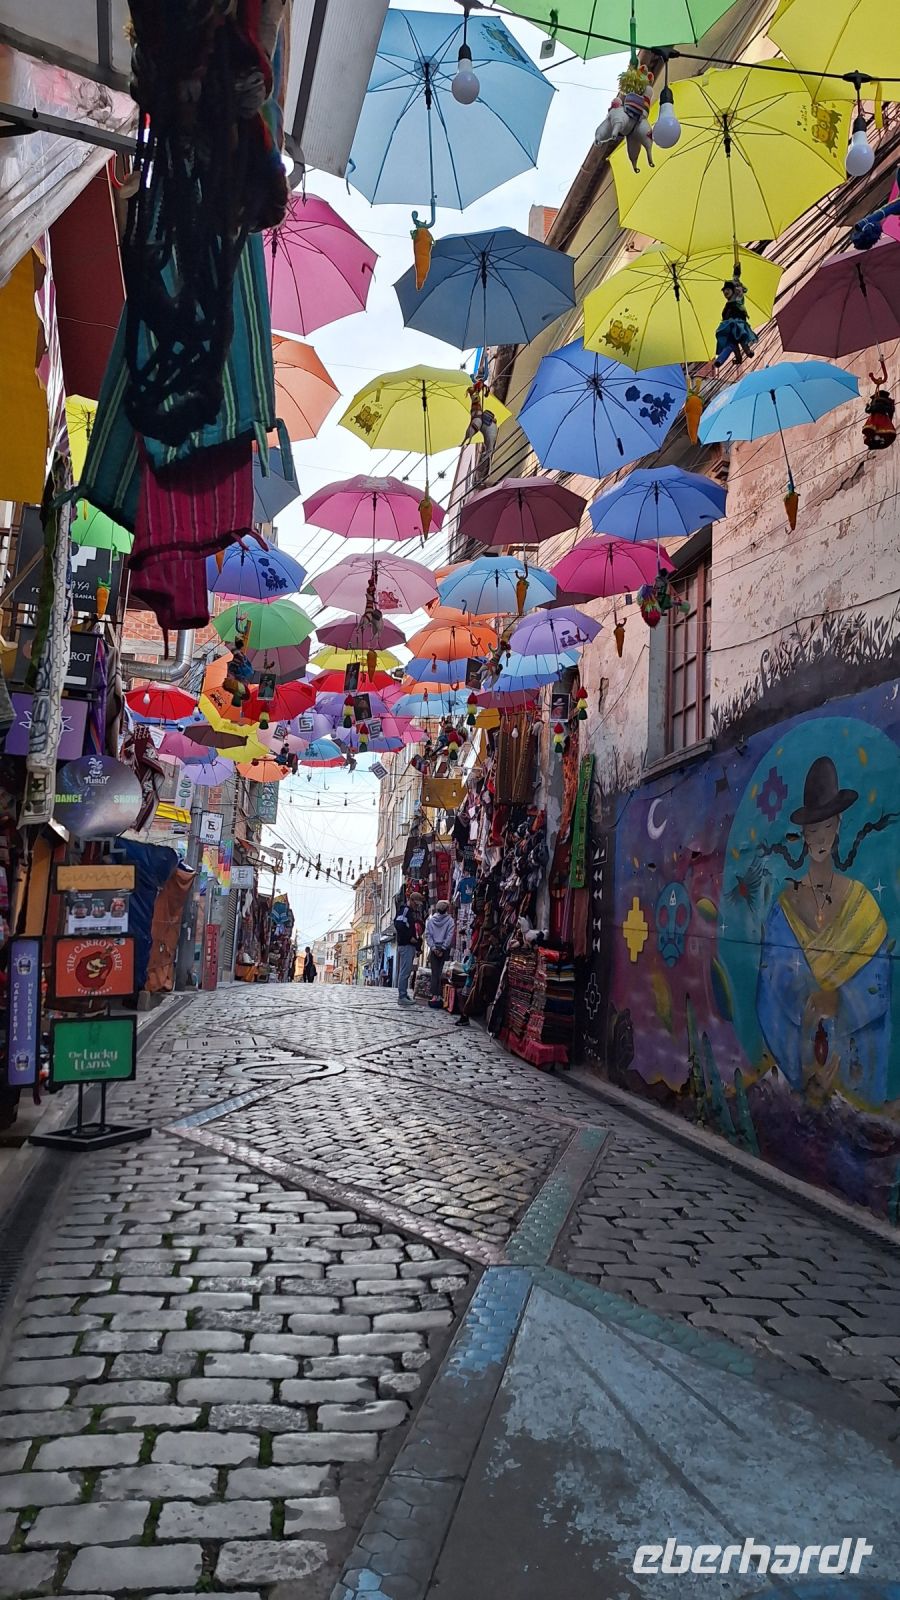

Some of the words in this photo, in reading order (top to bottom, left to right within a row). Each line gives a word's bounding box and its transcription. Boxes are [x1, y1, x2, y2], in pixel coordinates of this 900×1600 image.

[70, 651, 92, 663] ROT
[54, 794, 83, 803] DANCE
[66, 953, 77, 974] THE
[73, 939, 113, 954] CARROT
[111, 947, 123, 971] TREE
[83, 1048, 118, 1061] Lucky
